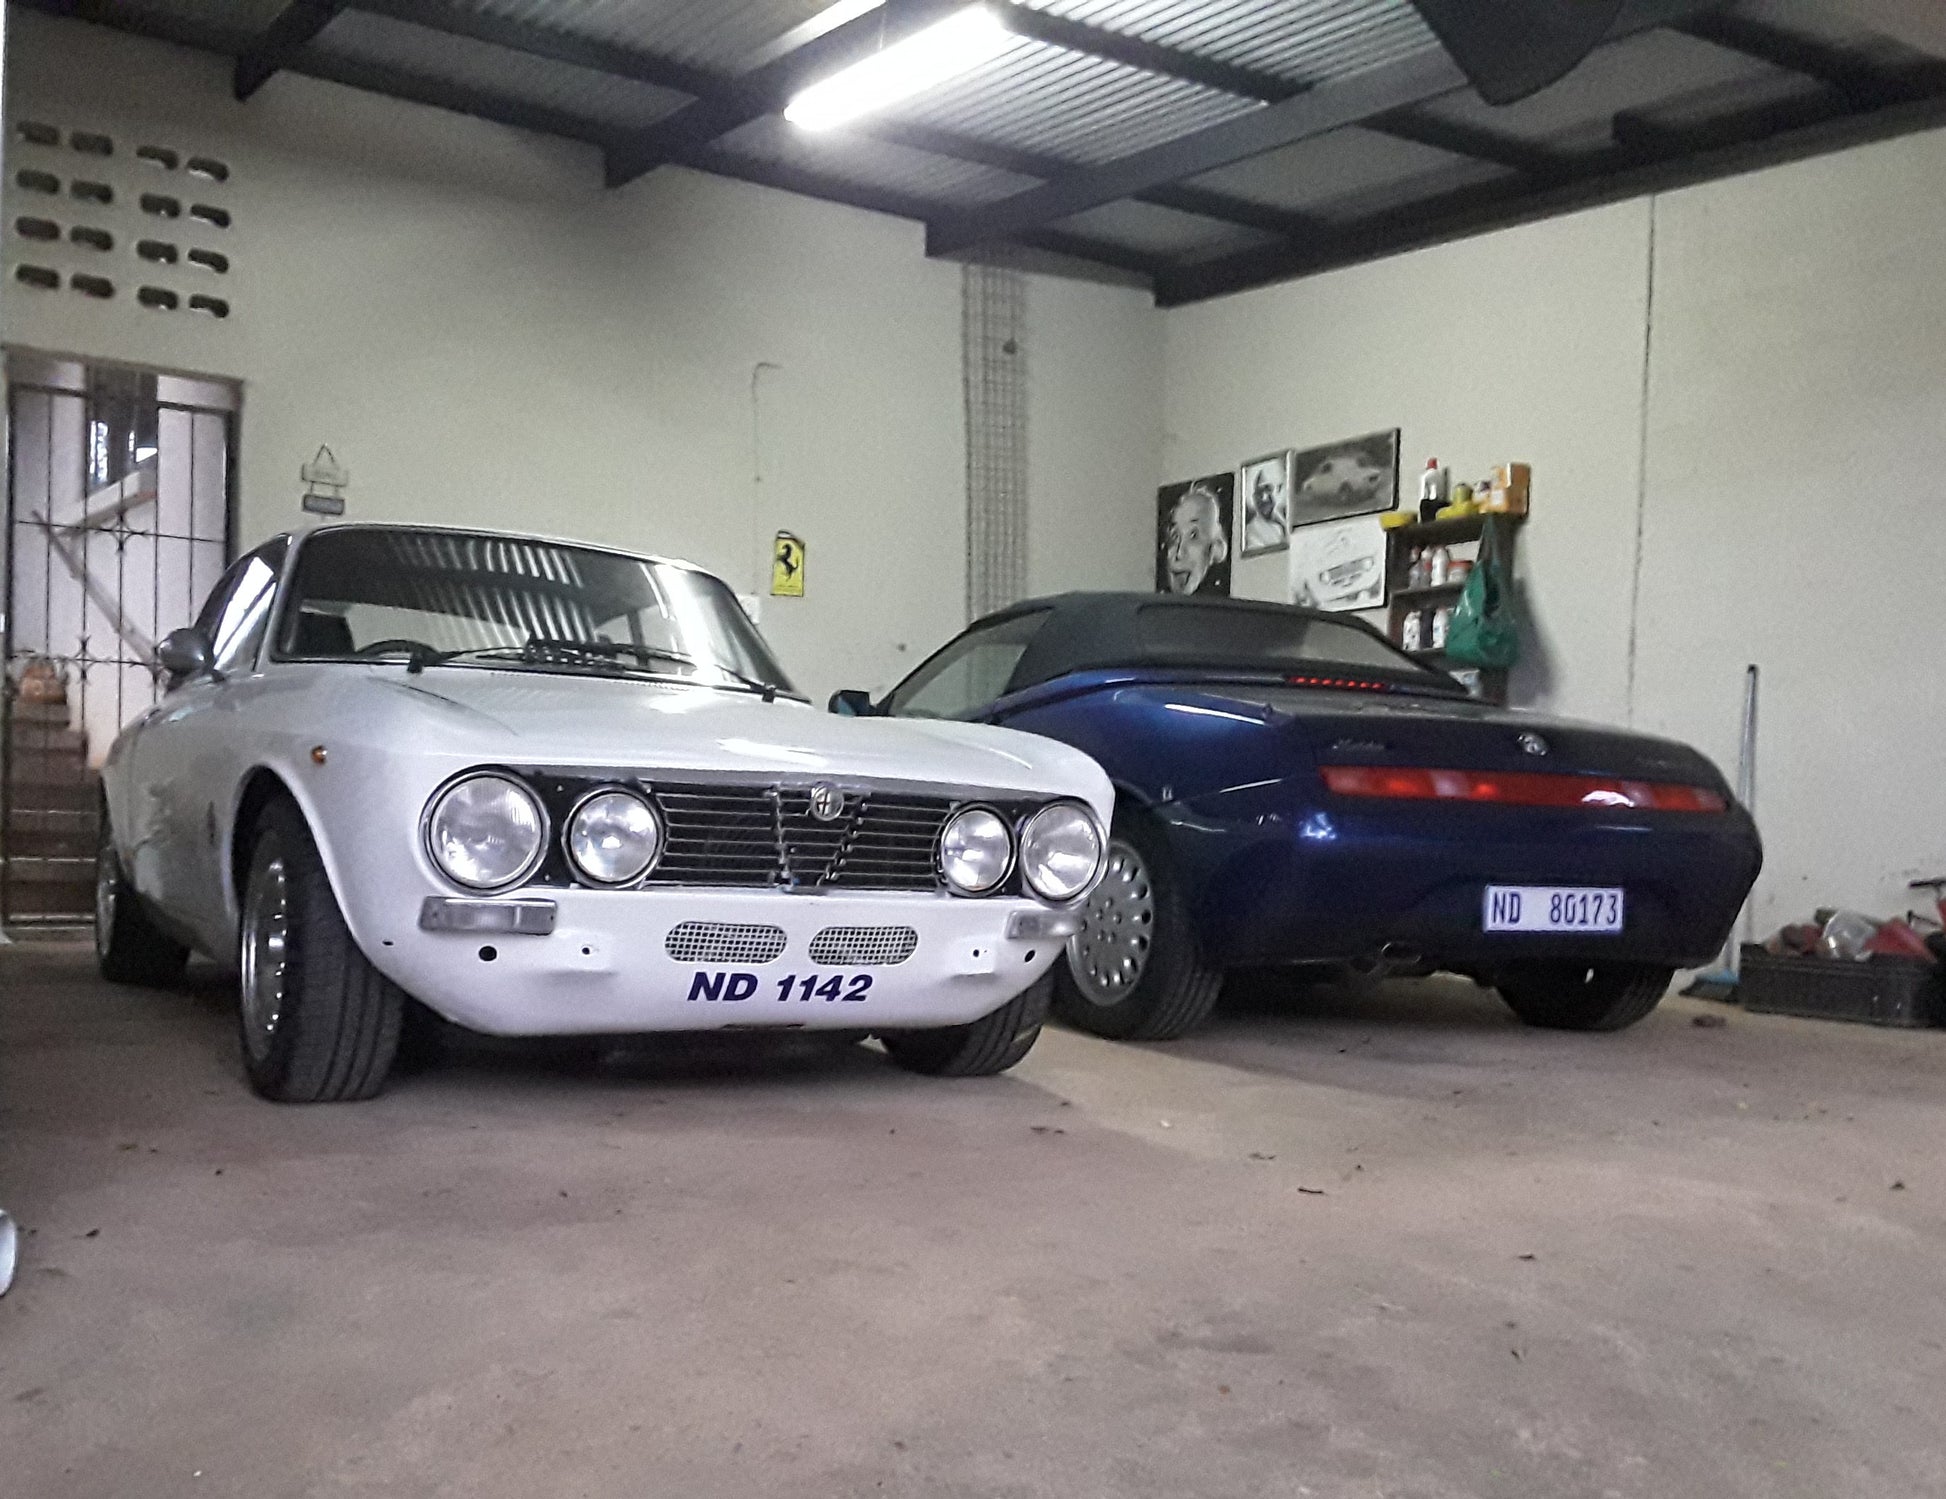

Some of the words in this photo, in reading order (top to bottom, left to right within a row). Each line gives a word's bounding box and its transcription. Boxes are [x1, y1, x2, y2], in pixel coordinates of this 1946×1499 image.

[1493, 893, 1521, 924] ND
[1550, 894, 1617, 925] 80173
[687, 971, 759, 1001] ND
[777, 974, 873, 1002] 1142
